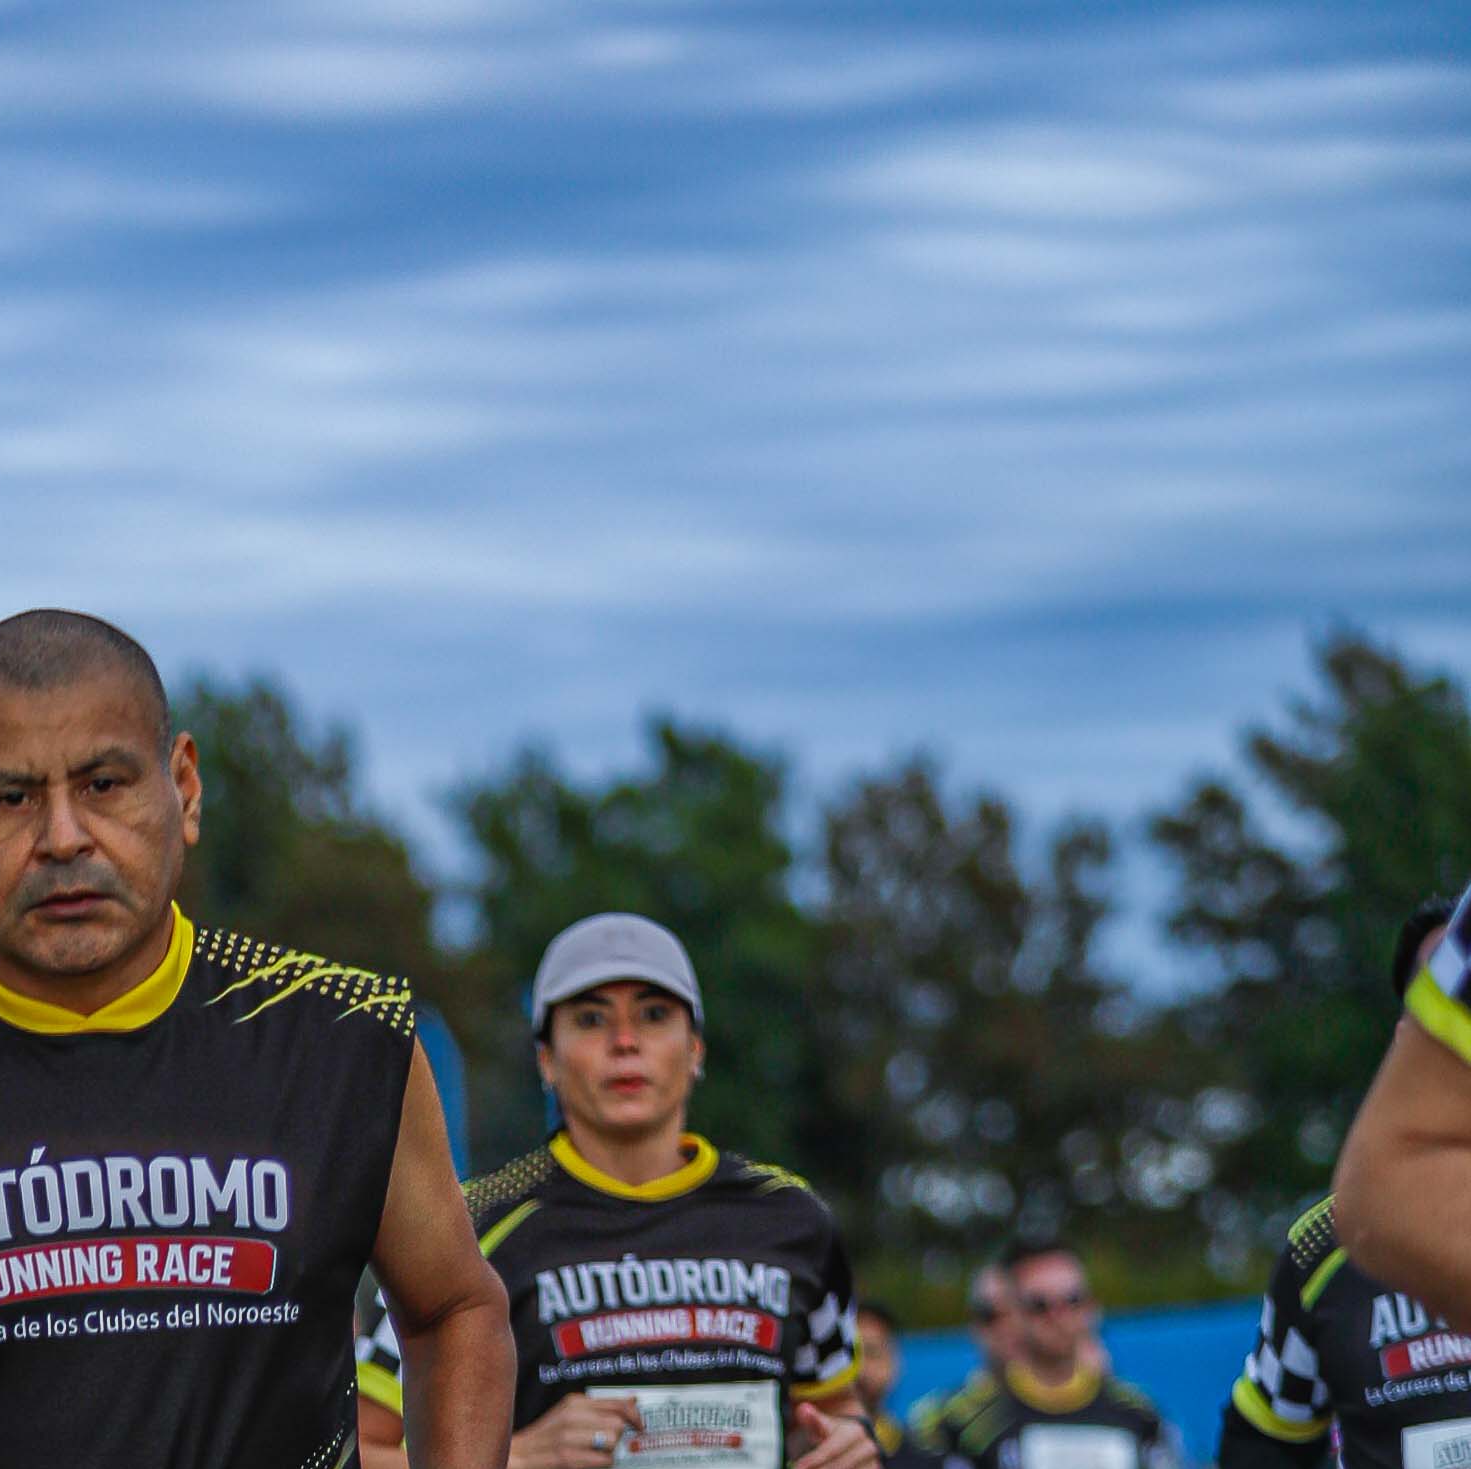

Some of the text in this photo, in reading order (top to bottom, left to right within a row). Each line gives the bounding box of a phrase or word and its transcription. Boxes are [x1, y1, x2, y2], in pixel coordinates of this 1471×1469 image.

[136, 1242, 234, 1286] RACE
[536, 1253, 791, 1325] AUTÓDROMO
[13, 1315, 40, 1338] de
[47, 1312, 78, 1337] los
[84, 1308, 160, 1333] Clubes
[166, 1303, 200, 1328] del
[207, 1301, 300, 1326] Noroeste
[580, 1307, 759, 1350] RUNNING RACE
